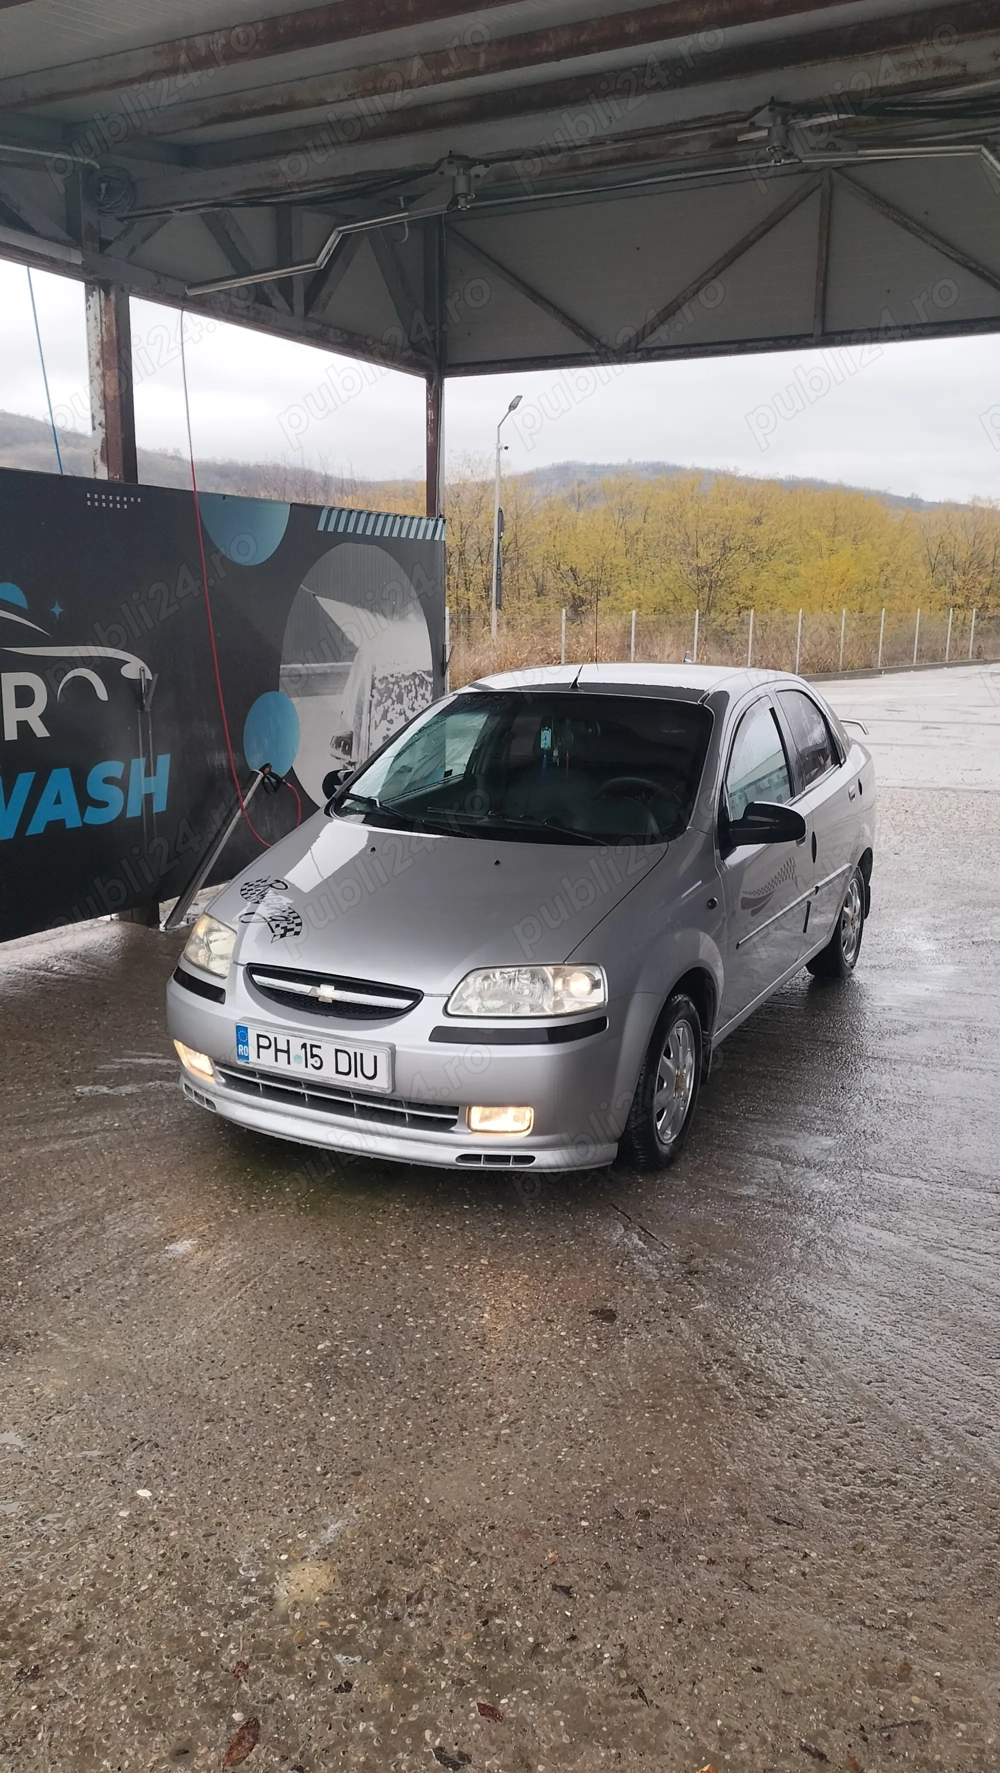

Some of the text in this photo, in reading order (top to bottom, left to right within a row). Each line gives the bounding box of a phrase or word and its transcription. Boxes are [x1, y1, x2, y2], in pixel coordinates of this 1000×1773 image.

[238, 1044, 249, 1057] RO
[256, 1033, 378, 1081] PH 15 DIU
